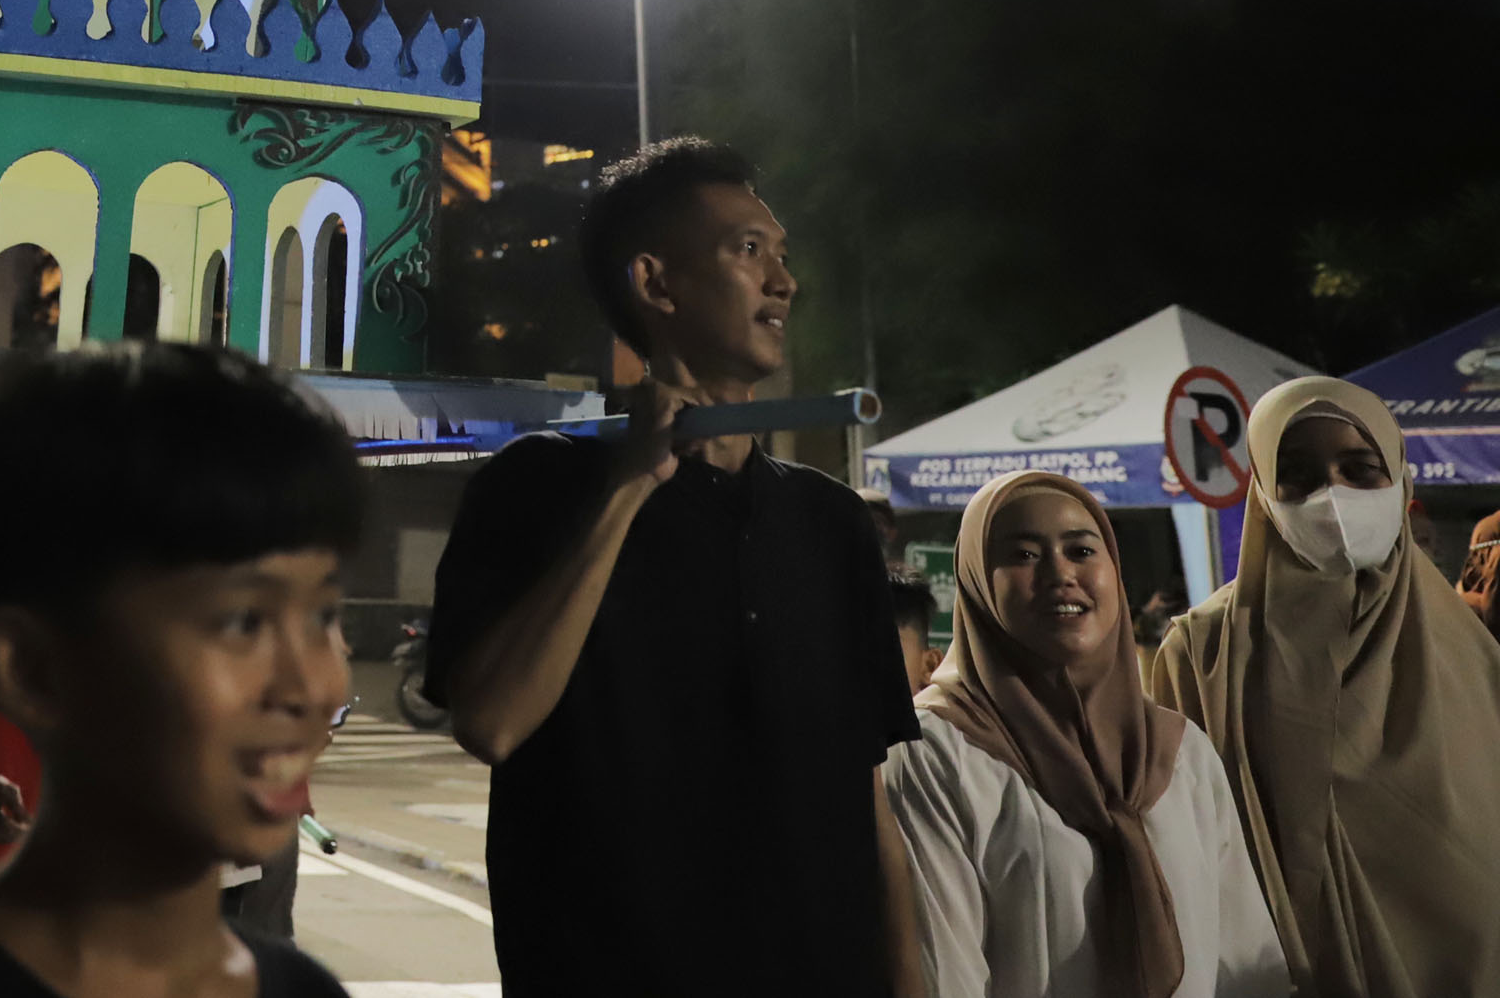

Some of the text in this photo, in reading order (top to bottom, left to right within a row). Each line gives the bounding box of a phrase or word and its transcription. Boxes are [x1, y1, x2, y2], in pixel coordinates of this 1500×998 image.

[918, 458, 951, 474] POS
[954, 455, 1027, 473] TERPADU
[1029, 452, 1093, 470] SATPOL
[1094, 450, 1119, 467] PP
[1190, 392, 1241, 482] P
